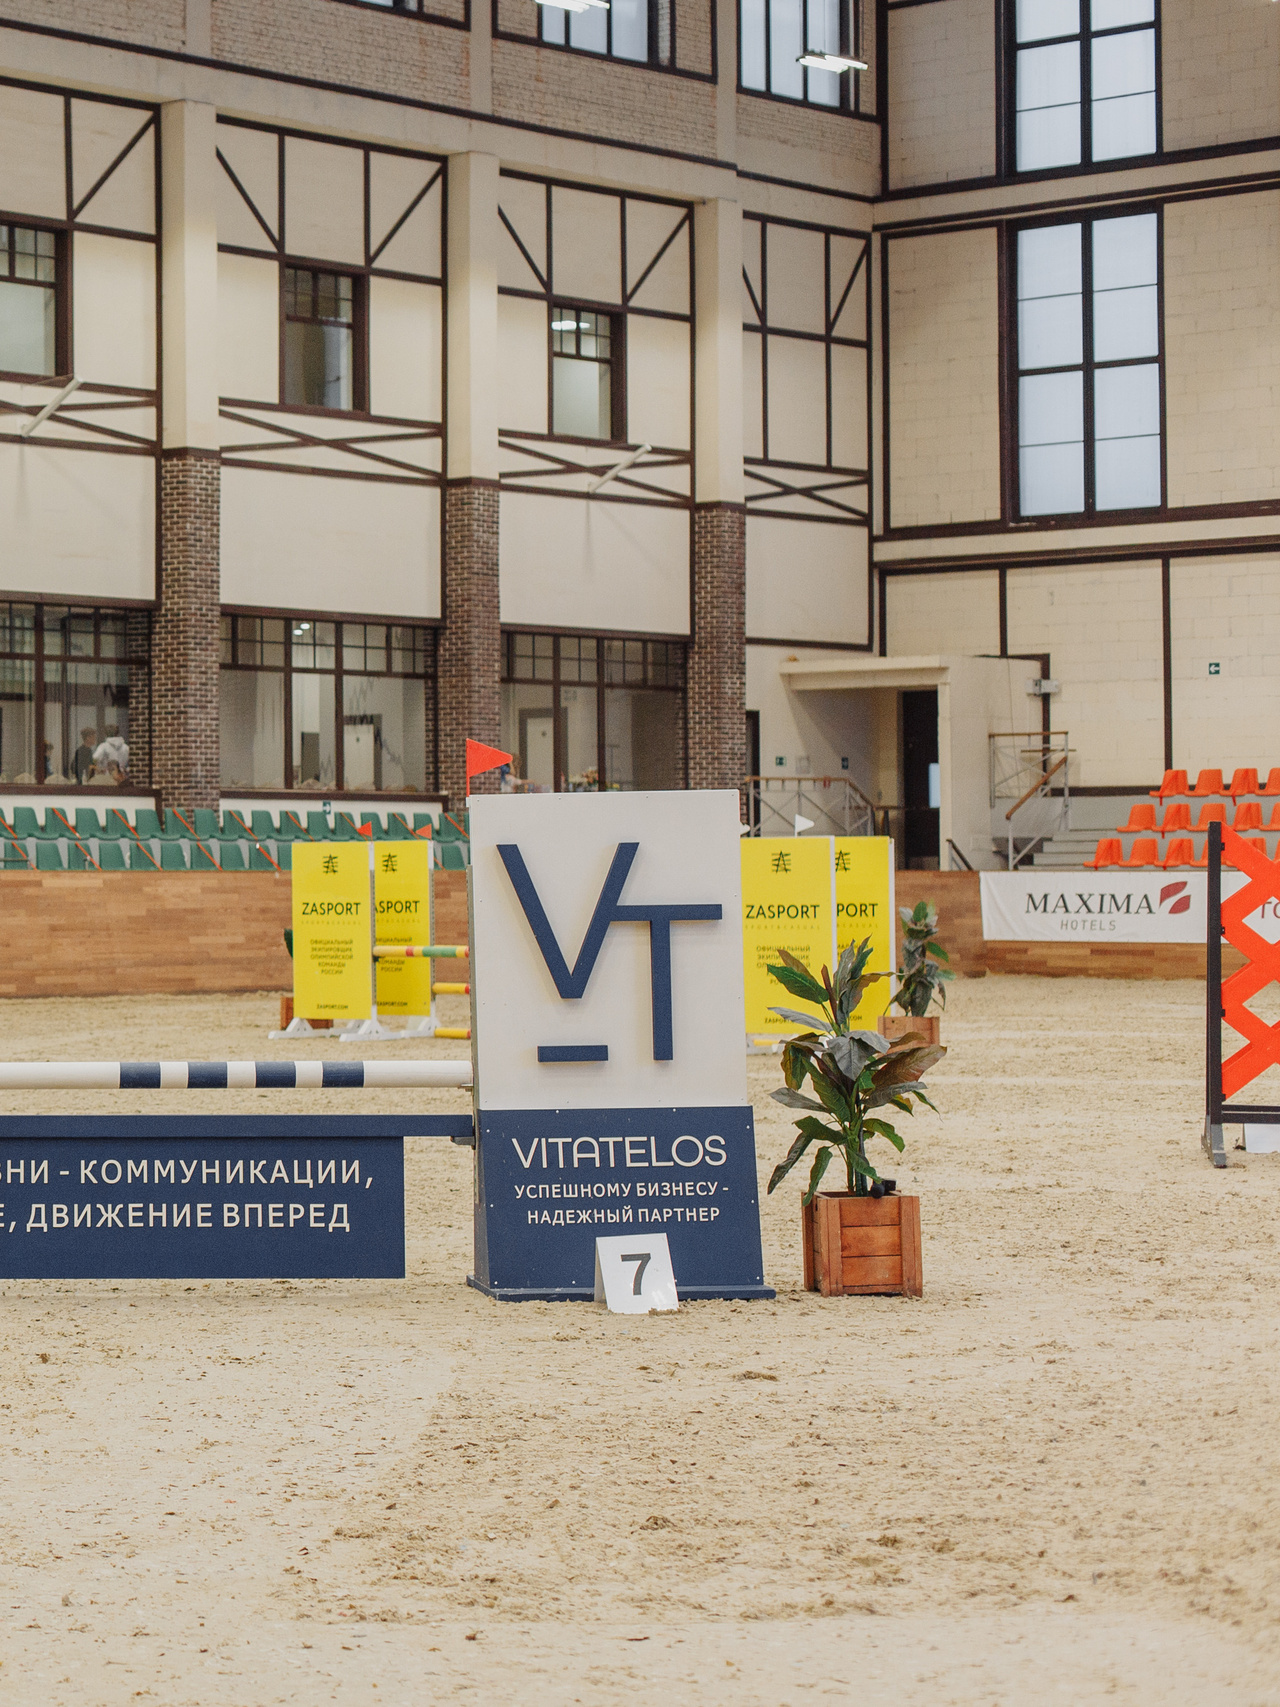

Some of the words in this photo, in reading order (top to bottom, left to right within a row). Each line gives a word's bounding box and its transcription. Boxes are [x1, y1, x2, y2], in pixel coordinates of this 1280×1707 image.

[302, 902, 361, 916] ZASPORT
[375, 900, 420, 914] SPORT
[745, 904, 820, 919] ZASPORT
[836, 902, 879, 918] PORT
[1025, 893, 1156, 915] MAXIMA
[1060, 919, 1117, 932] HOTELS
[376, 936, 413, 944] ИЦИАЛЬНЫЙ
[511, 1135, 727, 1169] VITATELOS
[80, 1159, 373, 1189] КОММУНИКАЦИИ,
[514, 1182, 632, 1199] УСПЕШНОМУ
[636, 1181, 718, 1197] БИЗНЕСУ
[26, 1202, 213, 1233] ДВИЖЕНИЕ
[223, 1203, 350, 1233] ВПЕРЕД
[527, 1204, 634, 1227] НАДЕЖНЫЙ
[638, 1207, 720, 1223] ПАРТНЕР
[620, 1252, 652, 1296] 7
